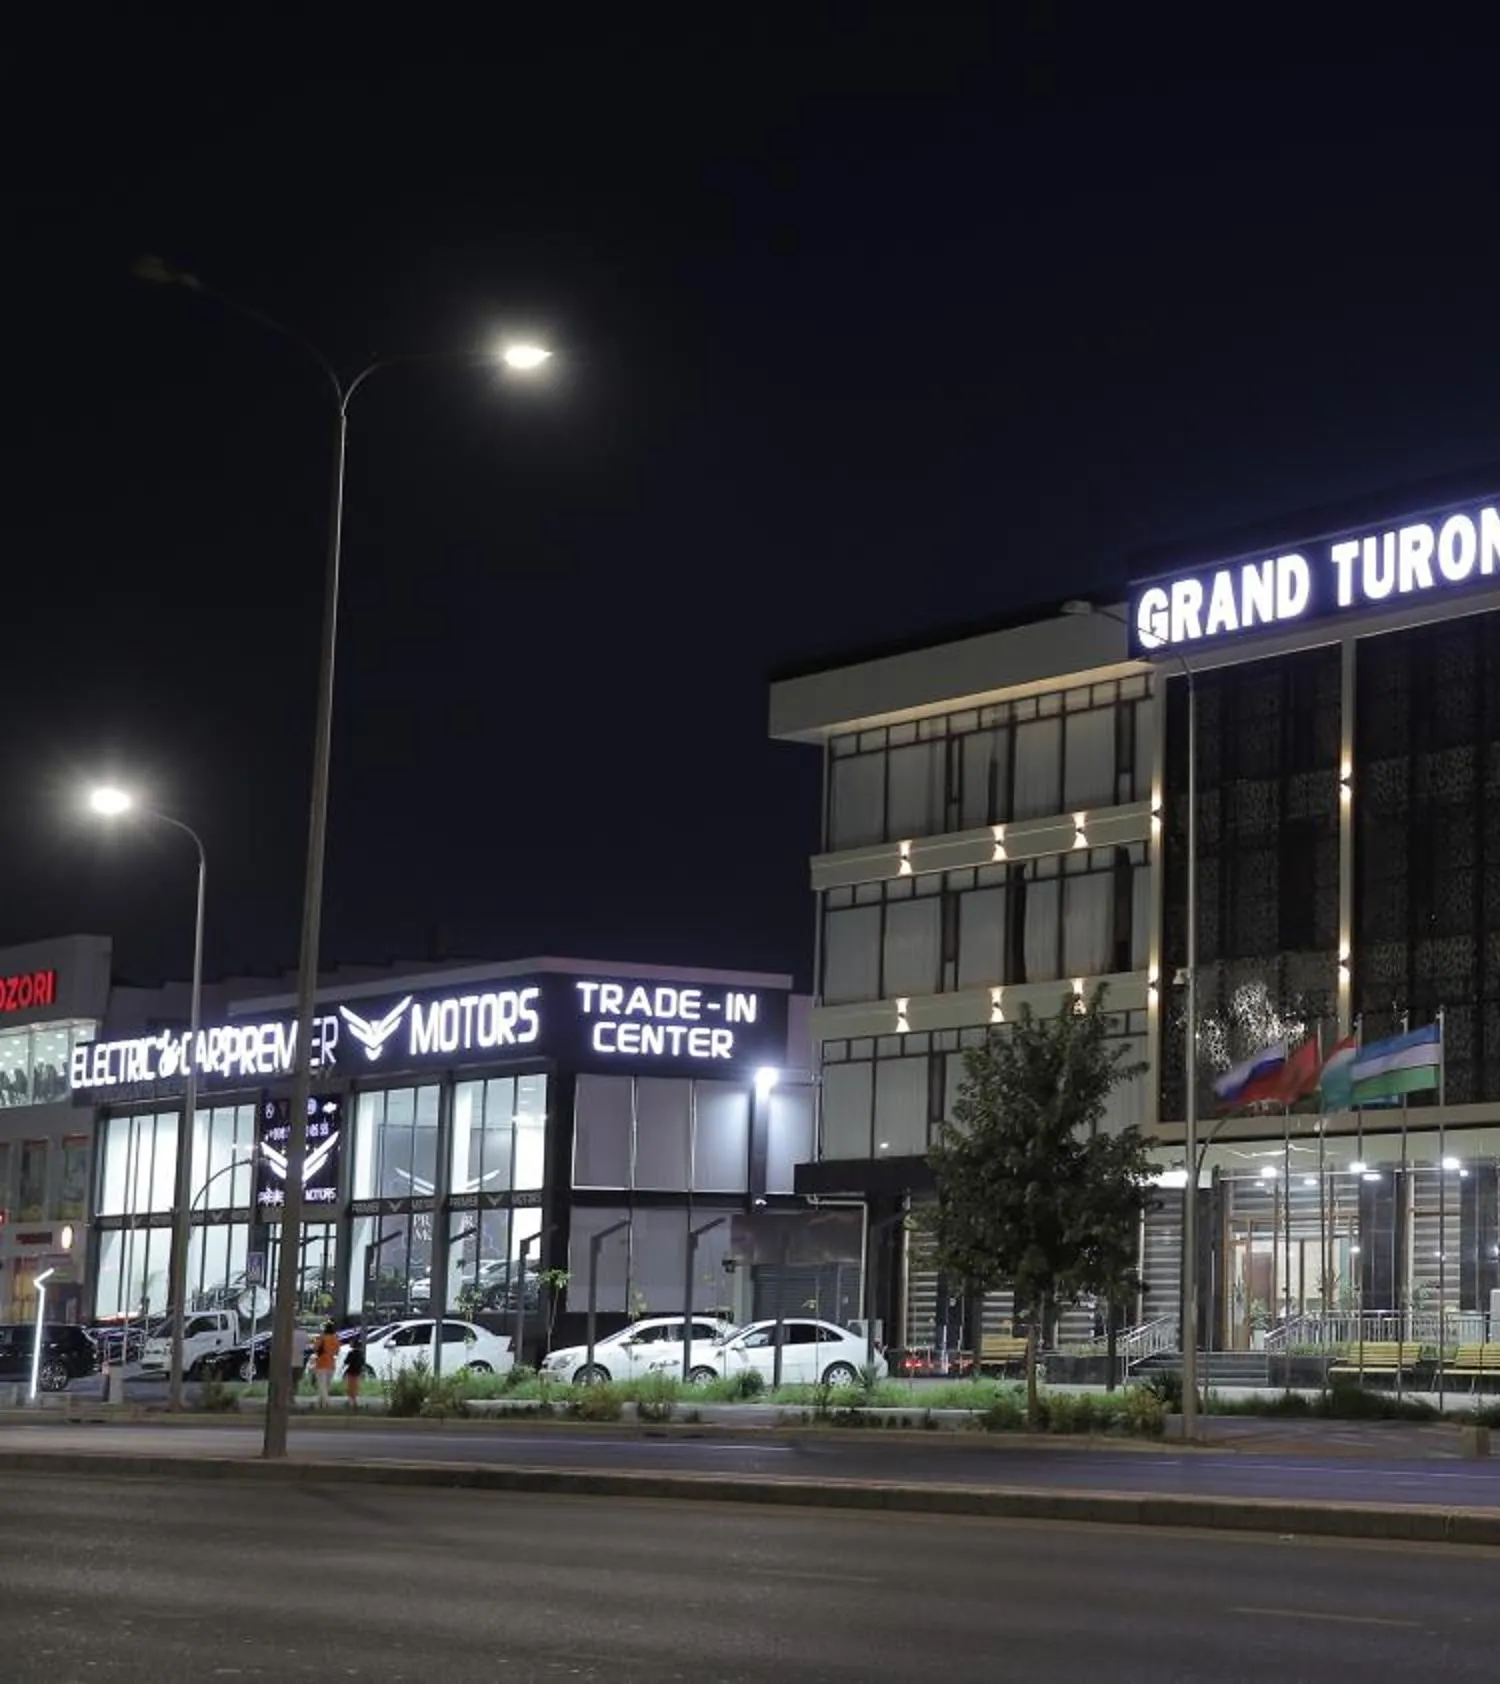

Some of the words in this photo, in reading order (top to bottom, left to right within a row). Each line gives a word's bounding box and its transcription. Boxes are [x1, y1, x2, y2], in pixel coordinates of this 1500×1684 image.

[1136, 552, 1311, 649] GRAND
[575, 981, 758, 1024] TRADE-IN
[223, 1015, 339, 1078] PREMER
[410, 987, 540, 1056] MOTORS
[592, 1021, 735, 1060] CENTER
[70, 1035, 157, 1089] ELECTRIC
